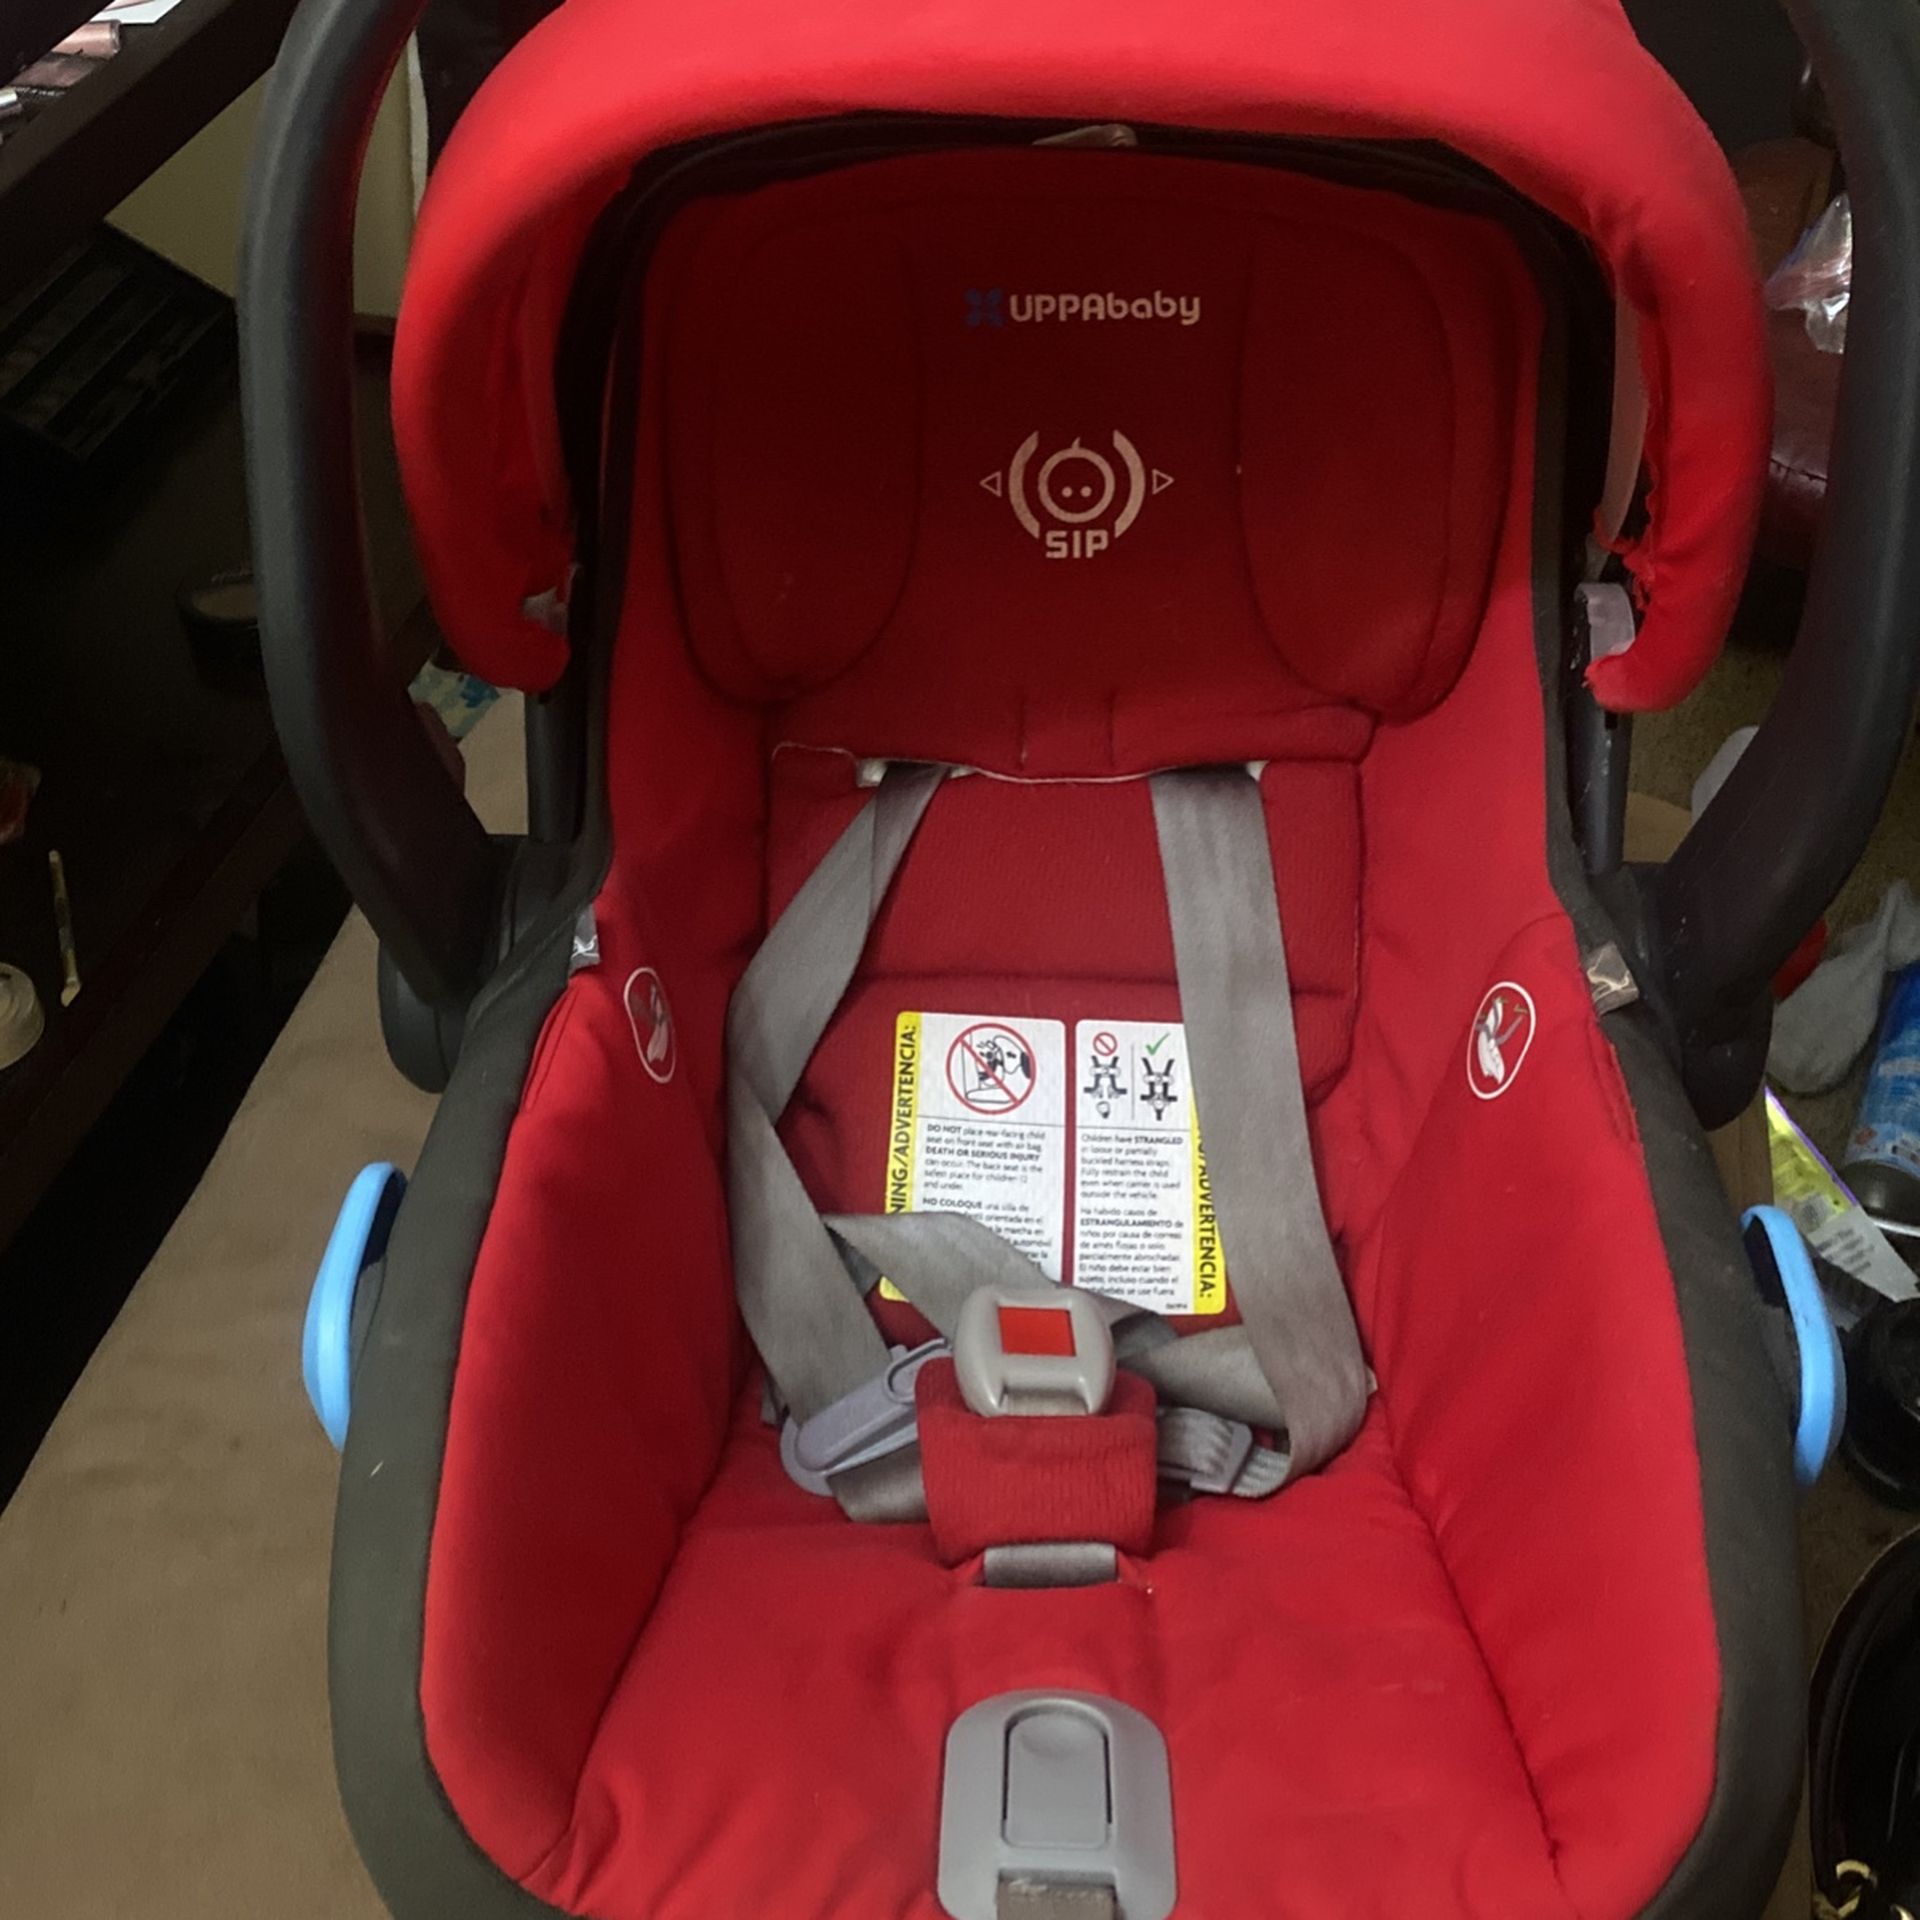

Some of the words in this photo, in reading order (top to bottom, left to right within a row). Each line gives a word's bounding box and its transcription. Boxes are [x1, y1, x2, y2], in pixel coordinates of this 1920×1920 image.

[1010, 290, 1200, 325] UPPAbaby
[1046, 529, 1108, 559] SIP
[891, 1026, 916, 1214] NING/ADVERTENCIA:
[928, 1124, 940, 1132] DO
[943, 1125, 962, 1134] NOT
[1027, 1131, 1045, 1139] child
[1081, 1134, 1111, 1142] Children
[1115, 1134, 1132, 1143] have
[1134, 1136, 1183, 1144] STRANGLED
[926, 1146, 954, 1155] DEATH
[971, 1150, 1007, 1159] SERIOUS
[1010, 1153, 1040, 1162] INJURY
[923, 1198, 937, 1206] NO
[940, 1199, 982, 1209] COLOQUE
[1080, 1219, 1172, 1228] ESTRANGULAMIENTO
